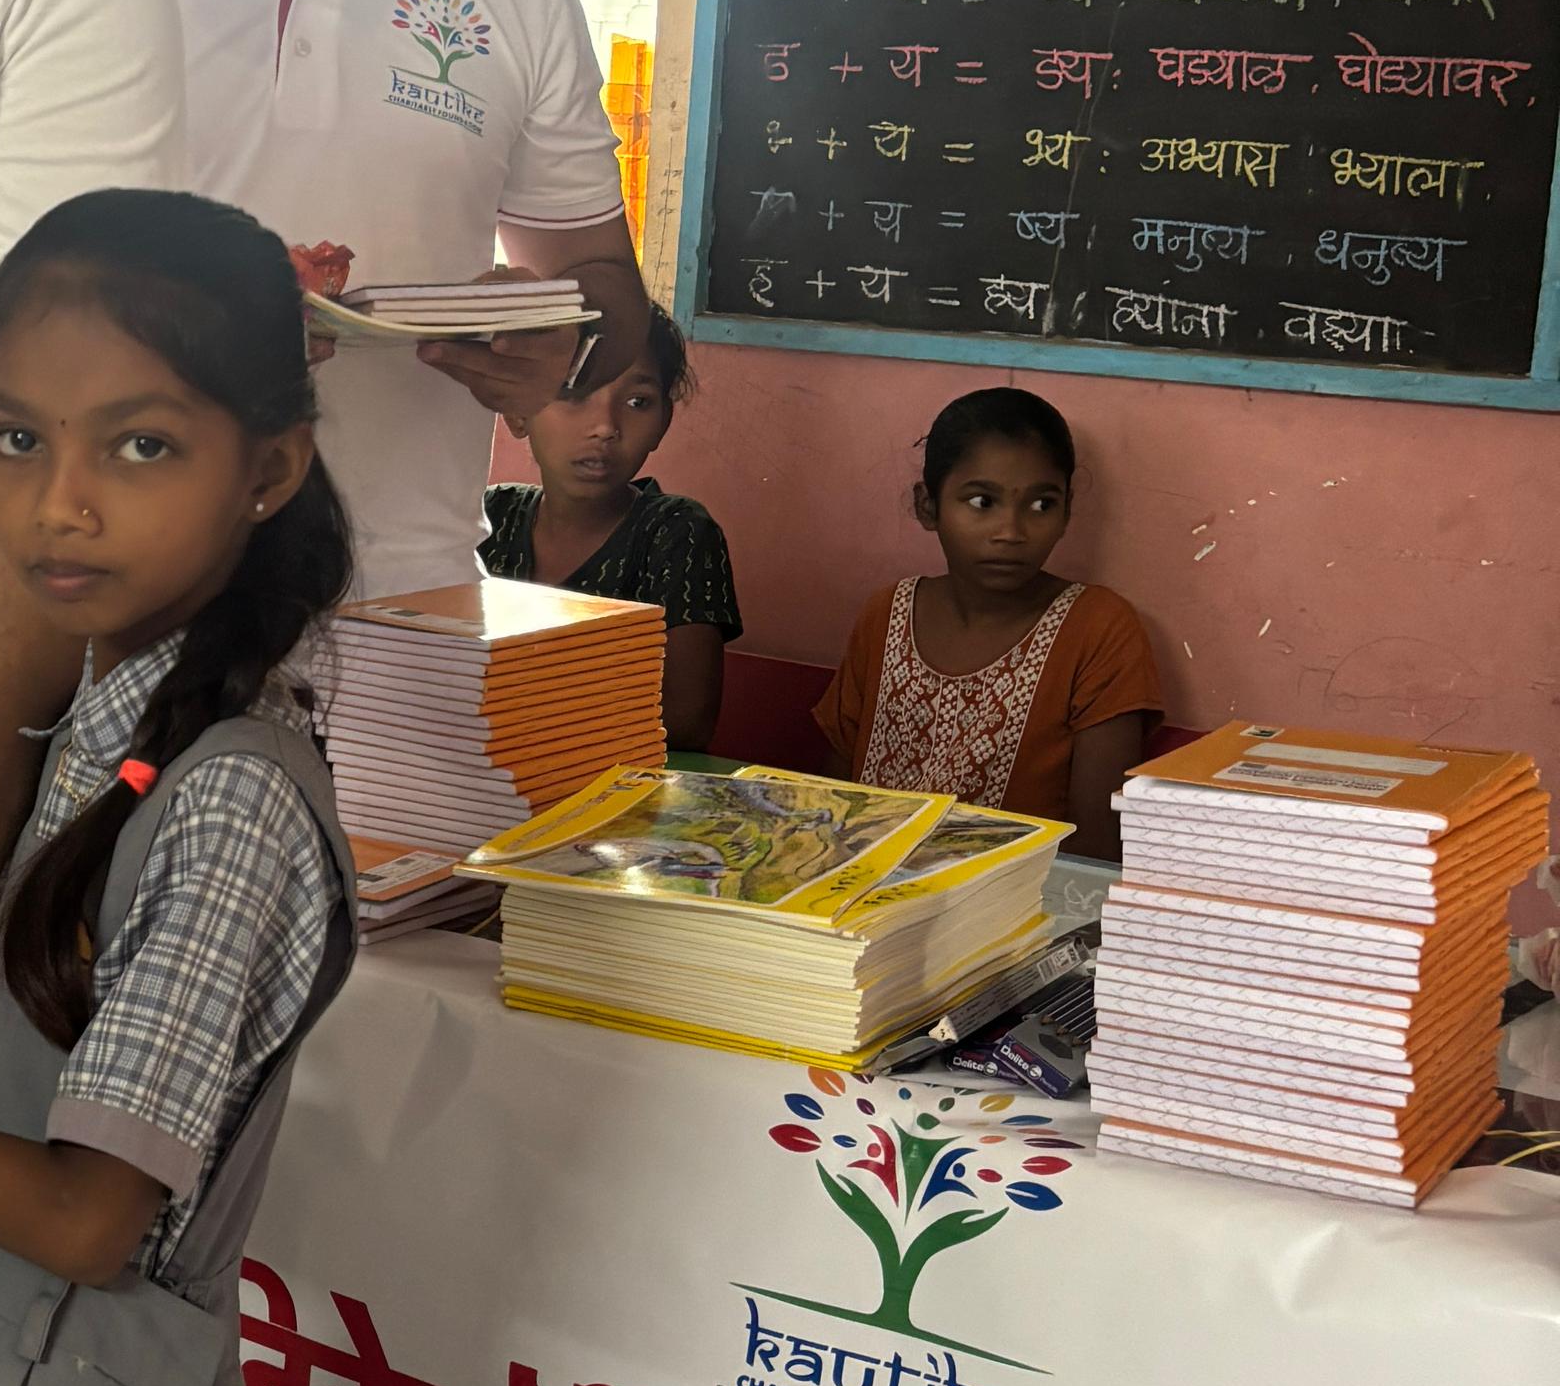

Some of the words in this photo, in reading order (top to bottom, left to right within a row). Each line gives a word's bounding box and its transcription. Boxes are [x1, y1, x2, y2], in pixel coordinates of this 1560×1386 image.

[880, 43, 939, 87] य
[866, 120, 916, 161] य
[864, 201, 913, 244] य
[847, 265, 909, 304] य
